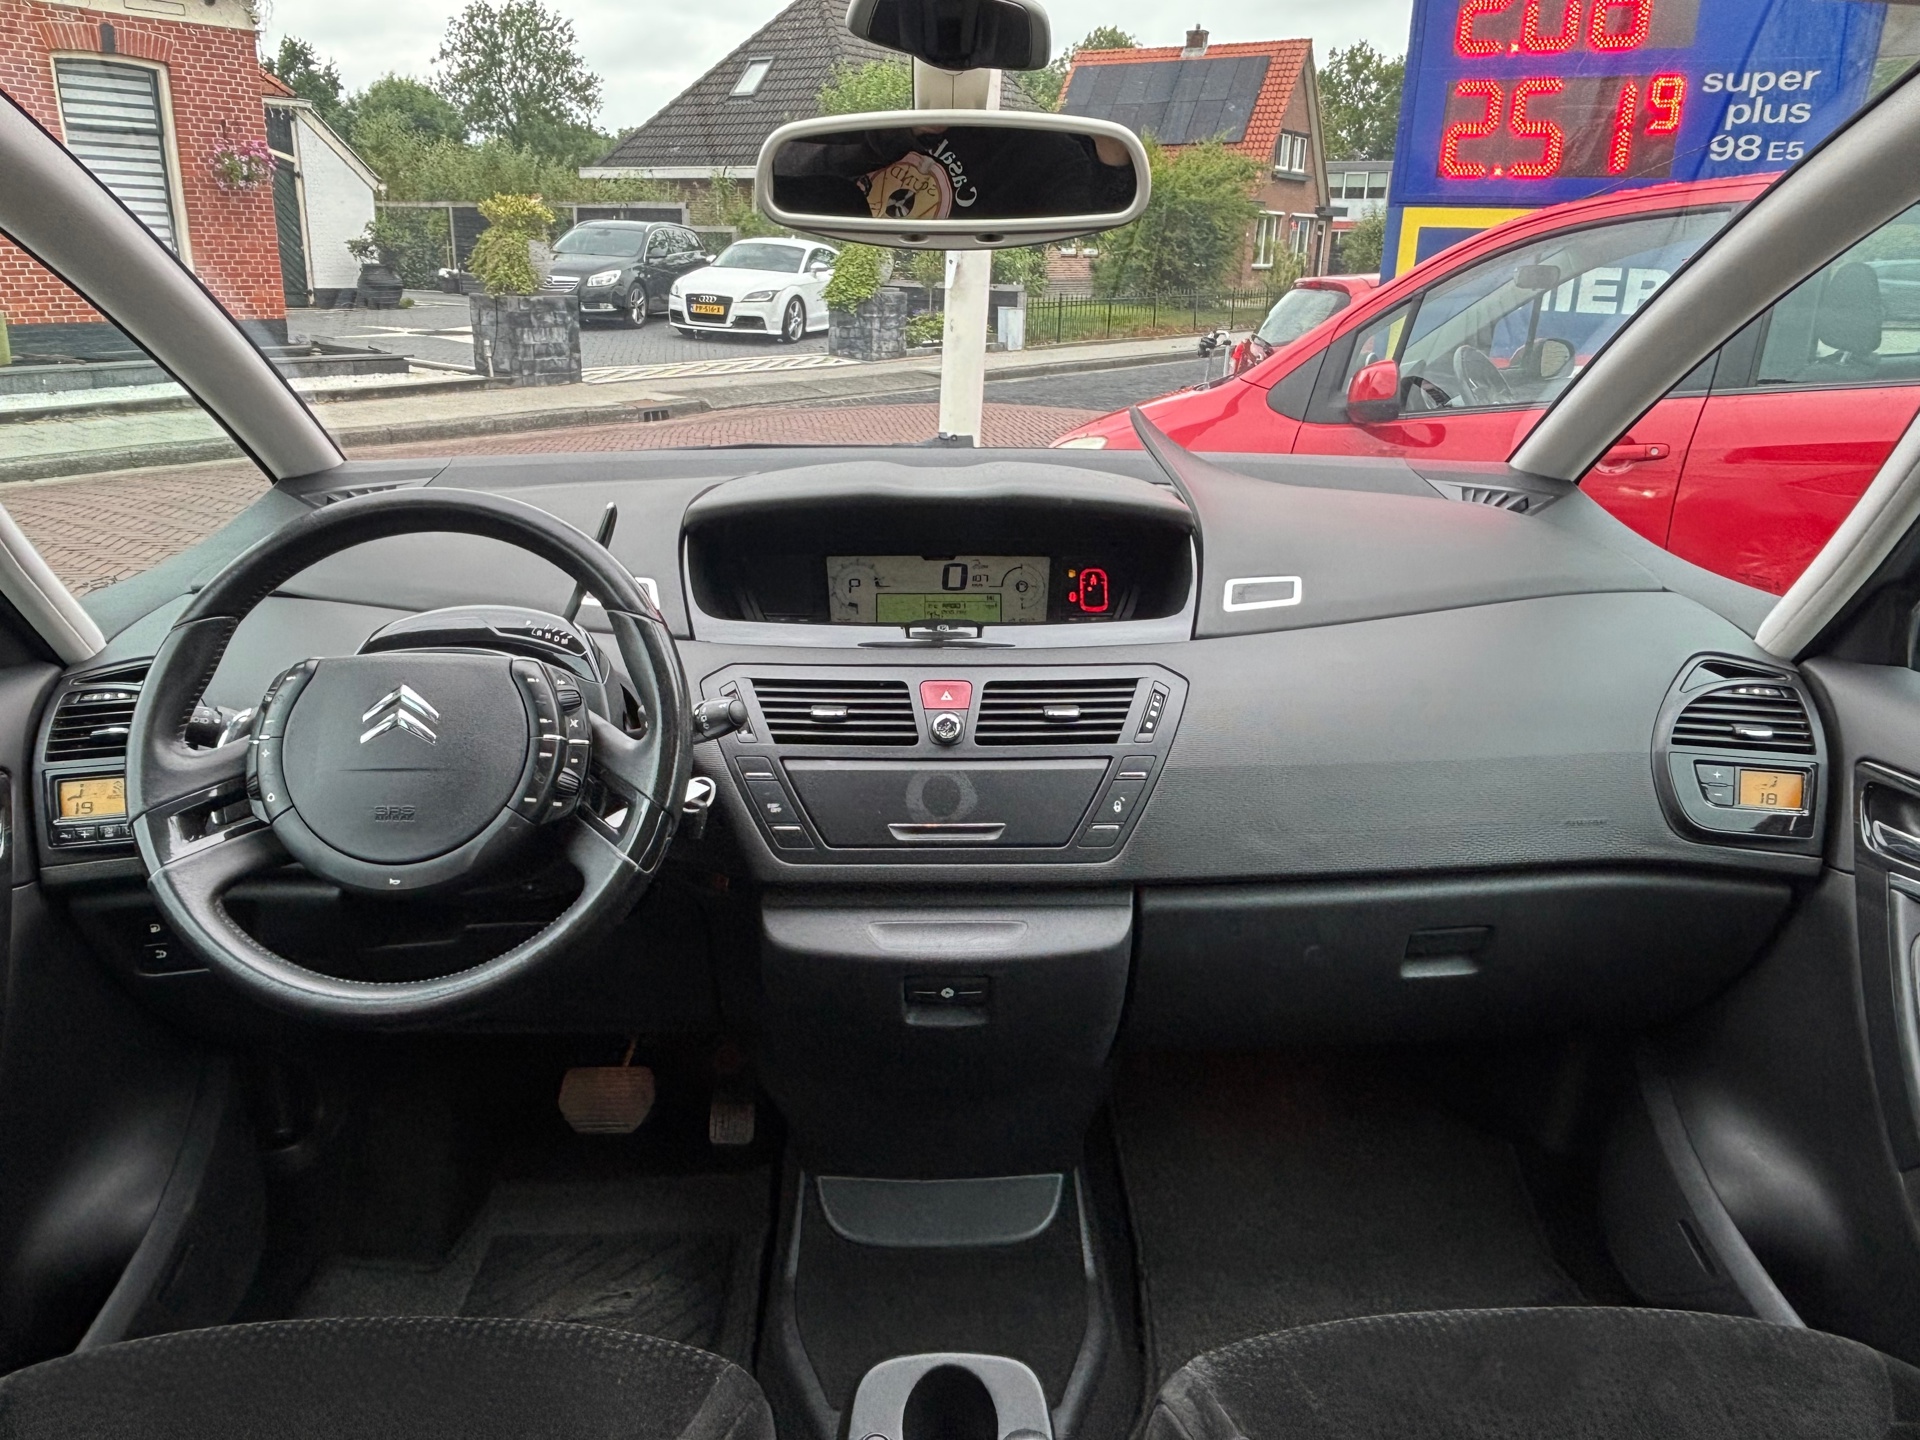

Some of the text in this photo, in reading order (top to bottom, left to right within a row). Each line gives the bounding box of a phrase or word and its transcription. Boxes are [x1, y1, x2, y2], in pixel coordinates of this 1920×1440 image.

[1702, 70, 1821, 98] super
[1725, 96, 1811, 130] plus
[1709, 134, 1804, 161] 98 E5
[849, 578, 861, 594] P
[942, 563, 968, 590] 0
[75, 801, 94, 815] 19
[1760, 792, 1778, 806] 18
